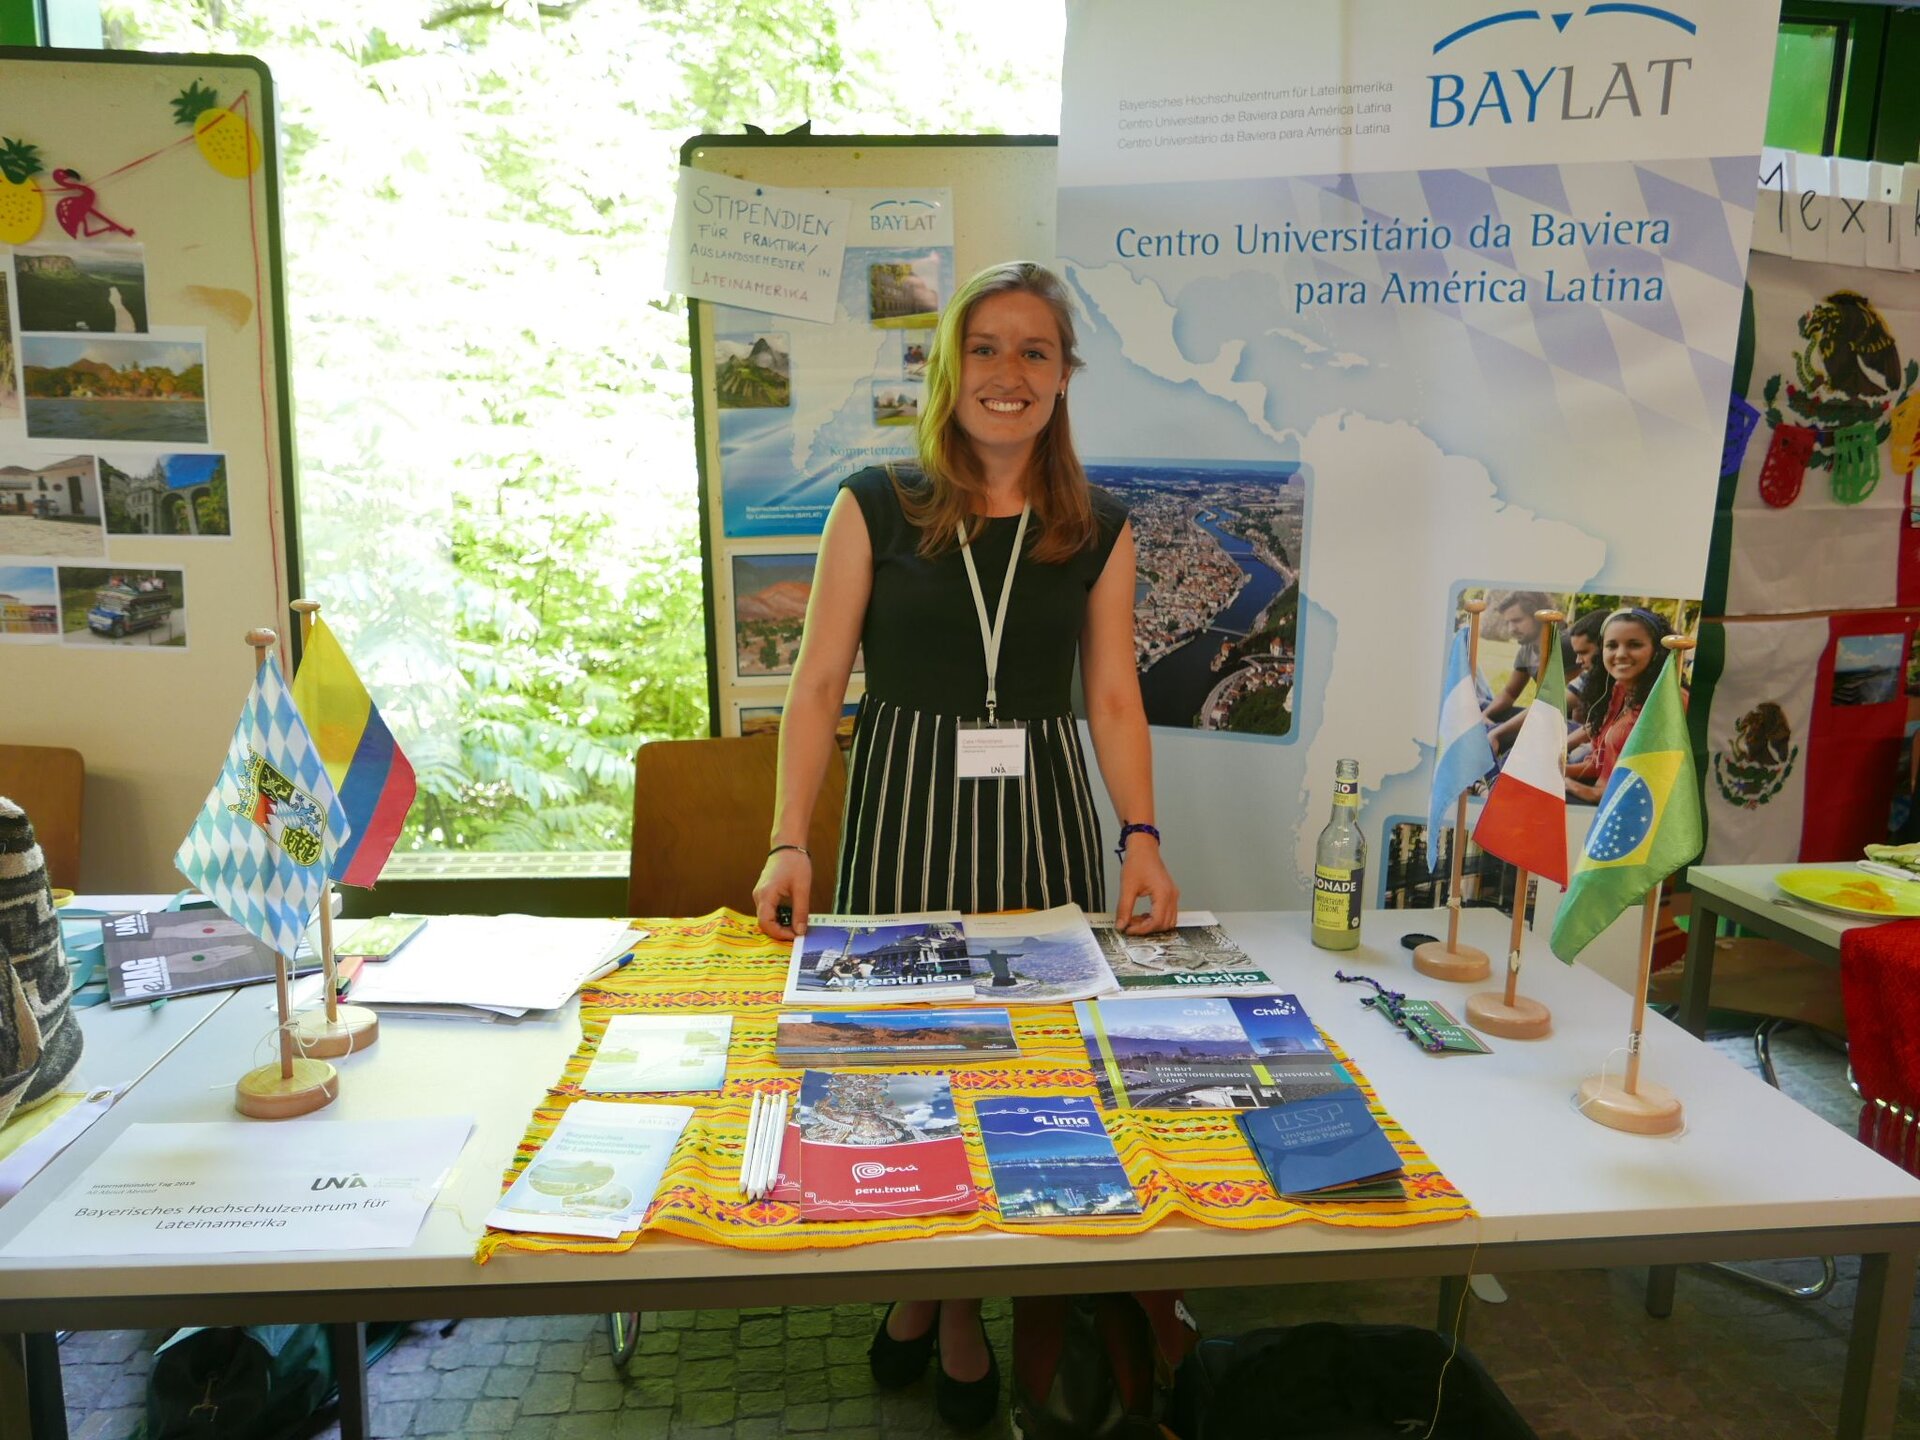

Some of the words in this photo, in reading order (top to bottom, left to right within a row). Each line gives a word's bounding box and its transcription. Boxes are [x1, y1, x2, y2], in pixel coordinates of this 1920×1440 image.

[1120, 98, 1183, 112] Bayerisches
[1185, 90, 1290, 105] Hochschulzentrum
[1292, 86, 1308, 99] für
[1310, 82, 1393, 97] Lateinamerika
[1427, 58, 1692, 128] BAYLAT
[1118, 119, 1153, 130] Centro
[1221, 113, 1235, 123] de
[1238, 110, 1278, 122] Baviera
[1280, 109, 1305, 120] para
[1307, 104, 1353, 117] América
[1357, 103, 1392, 114] Latina
[1118, 138, 1153, 149] Centro
[1221, 132, 1234, 143] da
[1237, 129, 1276, 142] Baviera
[1279, 128, 1303, 140] para
[1306, 125, 1352, 137] América
[1355, 123, 1390, 135] Latina
[693, 185, 834, 237] STIPENDIEN
[698, 222, 728, 240] FÜR
[870, 214, 937, 231] BAYLAT
[1116, 226, 1220, 259] Centro
[1235, 216, 1452, 257] Universitário
[1469, 215, 1511, 250] da
[1531, 212, 1671, 249] Baviera
[690, 243, 806, 272] AUSLANDSSEMESTER
[818, 267, 831, 278] IN
[690, 266, 809, 302] LATEINAMERIKA
[1295, 276, 1367, 315] para
[1381, 271, 1527, 306] América
[1545, 269, 1664, 302] Latina
[1315, 877, 1357, 892] ONADE
[825, 973, 962, 990] Argentinien
[1174, 973, 1259, 984] Mexiko
[1183, 1008, 1219, 1016] Chile
[1252, 1008, 1290, 1016] Chile
[1033, 1115, 1089, 1126] Lima
[1284, 1138, 1299, 1146] de
[1322, 1128, 1354, 1140] Paulo
[852, 1162, 919, 1183] Perú
[855, 1185, 921, 1196] peru.travel
[74, 1206, 183, 1219] Bayerisches
[188, 1199, 358, 1216] Hochschulzentrum
[361, 1197, 390, 1208] für
[154, 1217, 288, 1230] Lateinamerika
